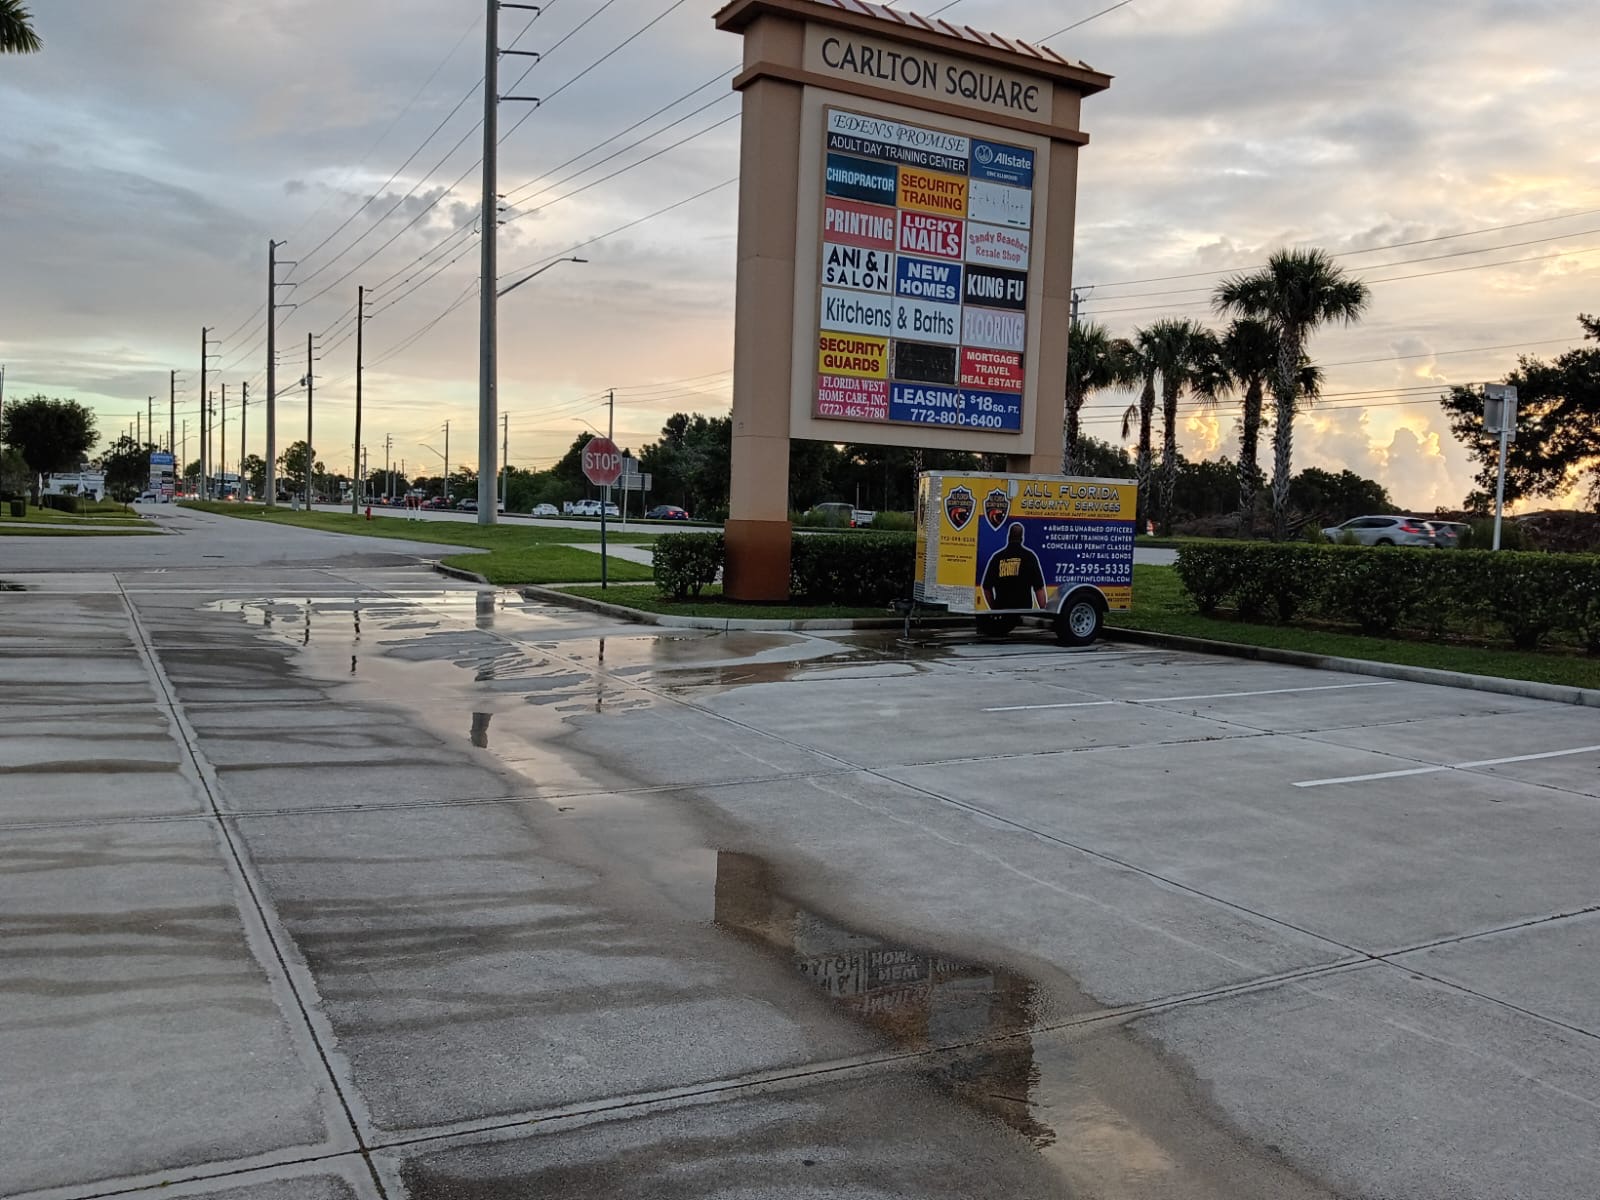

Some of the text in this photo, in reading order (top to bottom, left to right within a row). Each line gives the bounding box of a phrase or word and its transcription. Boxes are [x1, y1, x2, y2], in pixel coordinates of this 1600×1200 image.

[821, 37, 1039, 113] CARLTON SQUARE
[833, 114, 965, 153] EDEN'S PROMISE
[830, 135, 965, 171] ADULT DAY TRAINING CENTER
[994, 152, 1031, 169] Allstate
[826, 167, 895, 192] CHIROPRACTOR
[901, 173, 965, 196] SECURITY
[902, 189, 963, 211] TRAINING
[825, 207, 893, 241] PRINTING
[905, 214, 958, 234] LUCKY
[902, 226, 959, 256] NAILS
[969, 231, 1028, 253] Sandy Beaches
[828, 246, 889, 274] ANI & I
[976, 246, 1021, 264] Resale Shop
[826, 267, 888, 290] SALON
[907, 262, 949, 282] NEW
[900, 279, 956, 299] HOMES
[967, 273, 1024, 301] KUNG FU
[826, 296, 954, 335] Kitchens & Baths
[964, 312, 1022, 346] FLOORING
[820, 337, 885, 357] SECURITY
[824, 354, 880, 373] GUARDS
[966, 351, 1019, 366] MORTGAGE
[975, 363, 1010, 376] TRAVEL
[823, 376, 885, 392] FLORIDA WEST
[961, 374, 1022, 389] REAL ESTATE
[819, 389, 888, 406] HOME CARE, INC.
[893, 387, 965, 409] LEASING
[970, 395, 992, 411] $18
[1008, 405, 1019, 415] FT.
[820, 403, 885, 418] (772) 465-7780
[910, 408, 1002, 428] 772-800-6400
[585, 452, 619, 471] STOP
[1023, 483, 1119, 500] ALL FLORIDA
[1020, 499, 1069, 511] SECURITY
[1075, 501, 1120, 513] SERVICES
[1080, 534, 1108, 542] TRAINING
[1105, 526, 1133, 534] OFFICERS
[1055, 563, 1130, 575] 772-595-5335
[1055, 575, 1130, 583] SECURITYINFLORIDA.COM
